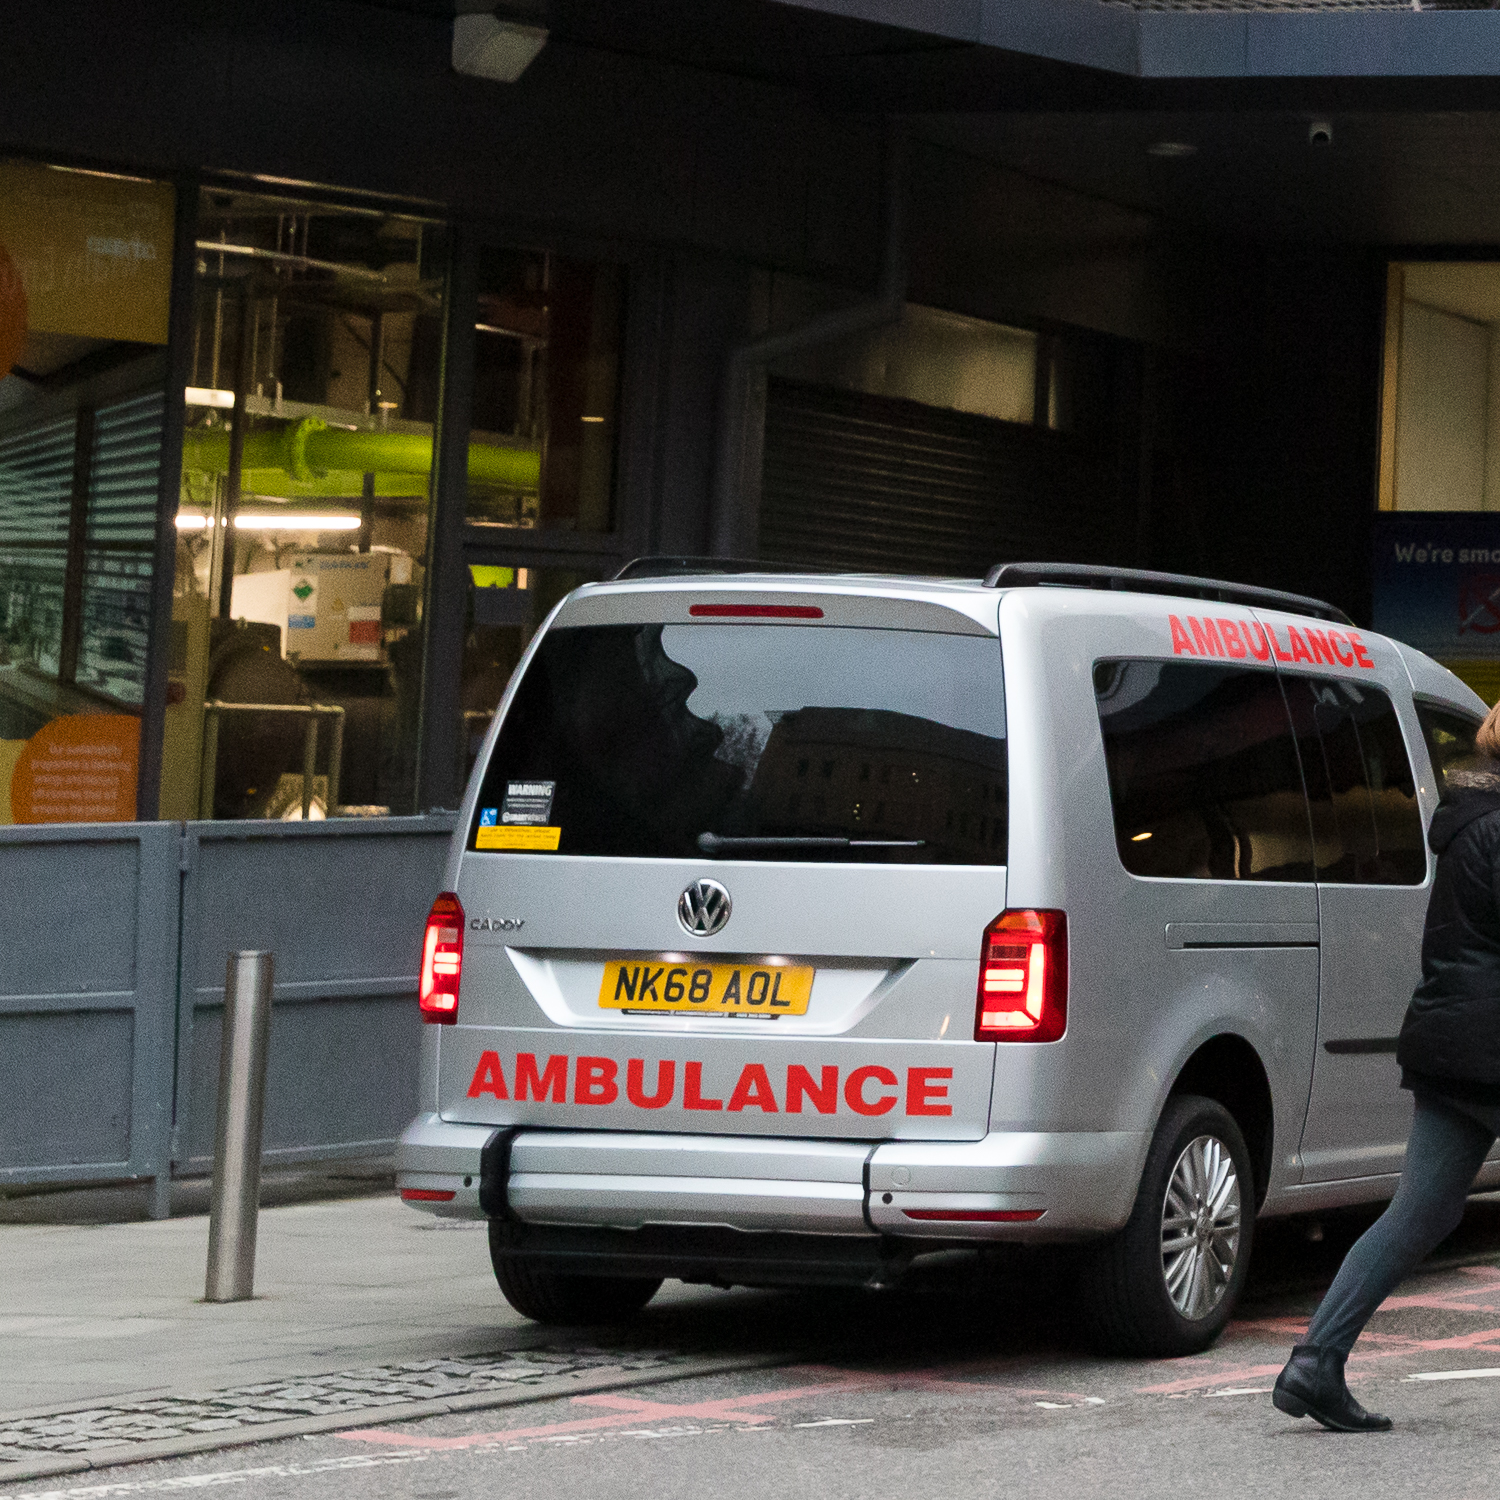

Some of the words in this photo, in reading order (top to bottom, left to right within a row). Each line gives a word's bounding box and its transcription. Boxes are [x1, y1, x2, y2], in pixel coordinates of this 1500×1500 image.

[1394, 542, 1454, 563] We're
[1167, 614, 1376, 669] AMBULANCE
[508, 784, 553, 797] WARNING
[470, 918, 525, 931] CADDY
[613, 966, 713, 1003] NK68
[720, 971, 791, 1007] AOL
[466, 1050, 956, 1118] AMBULANCE
